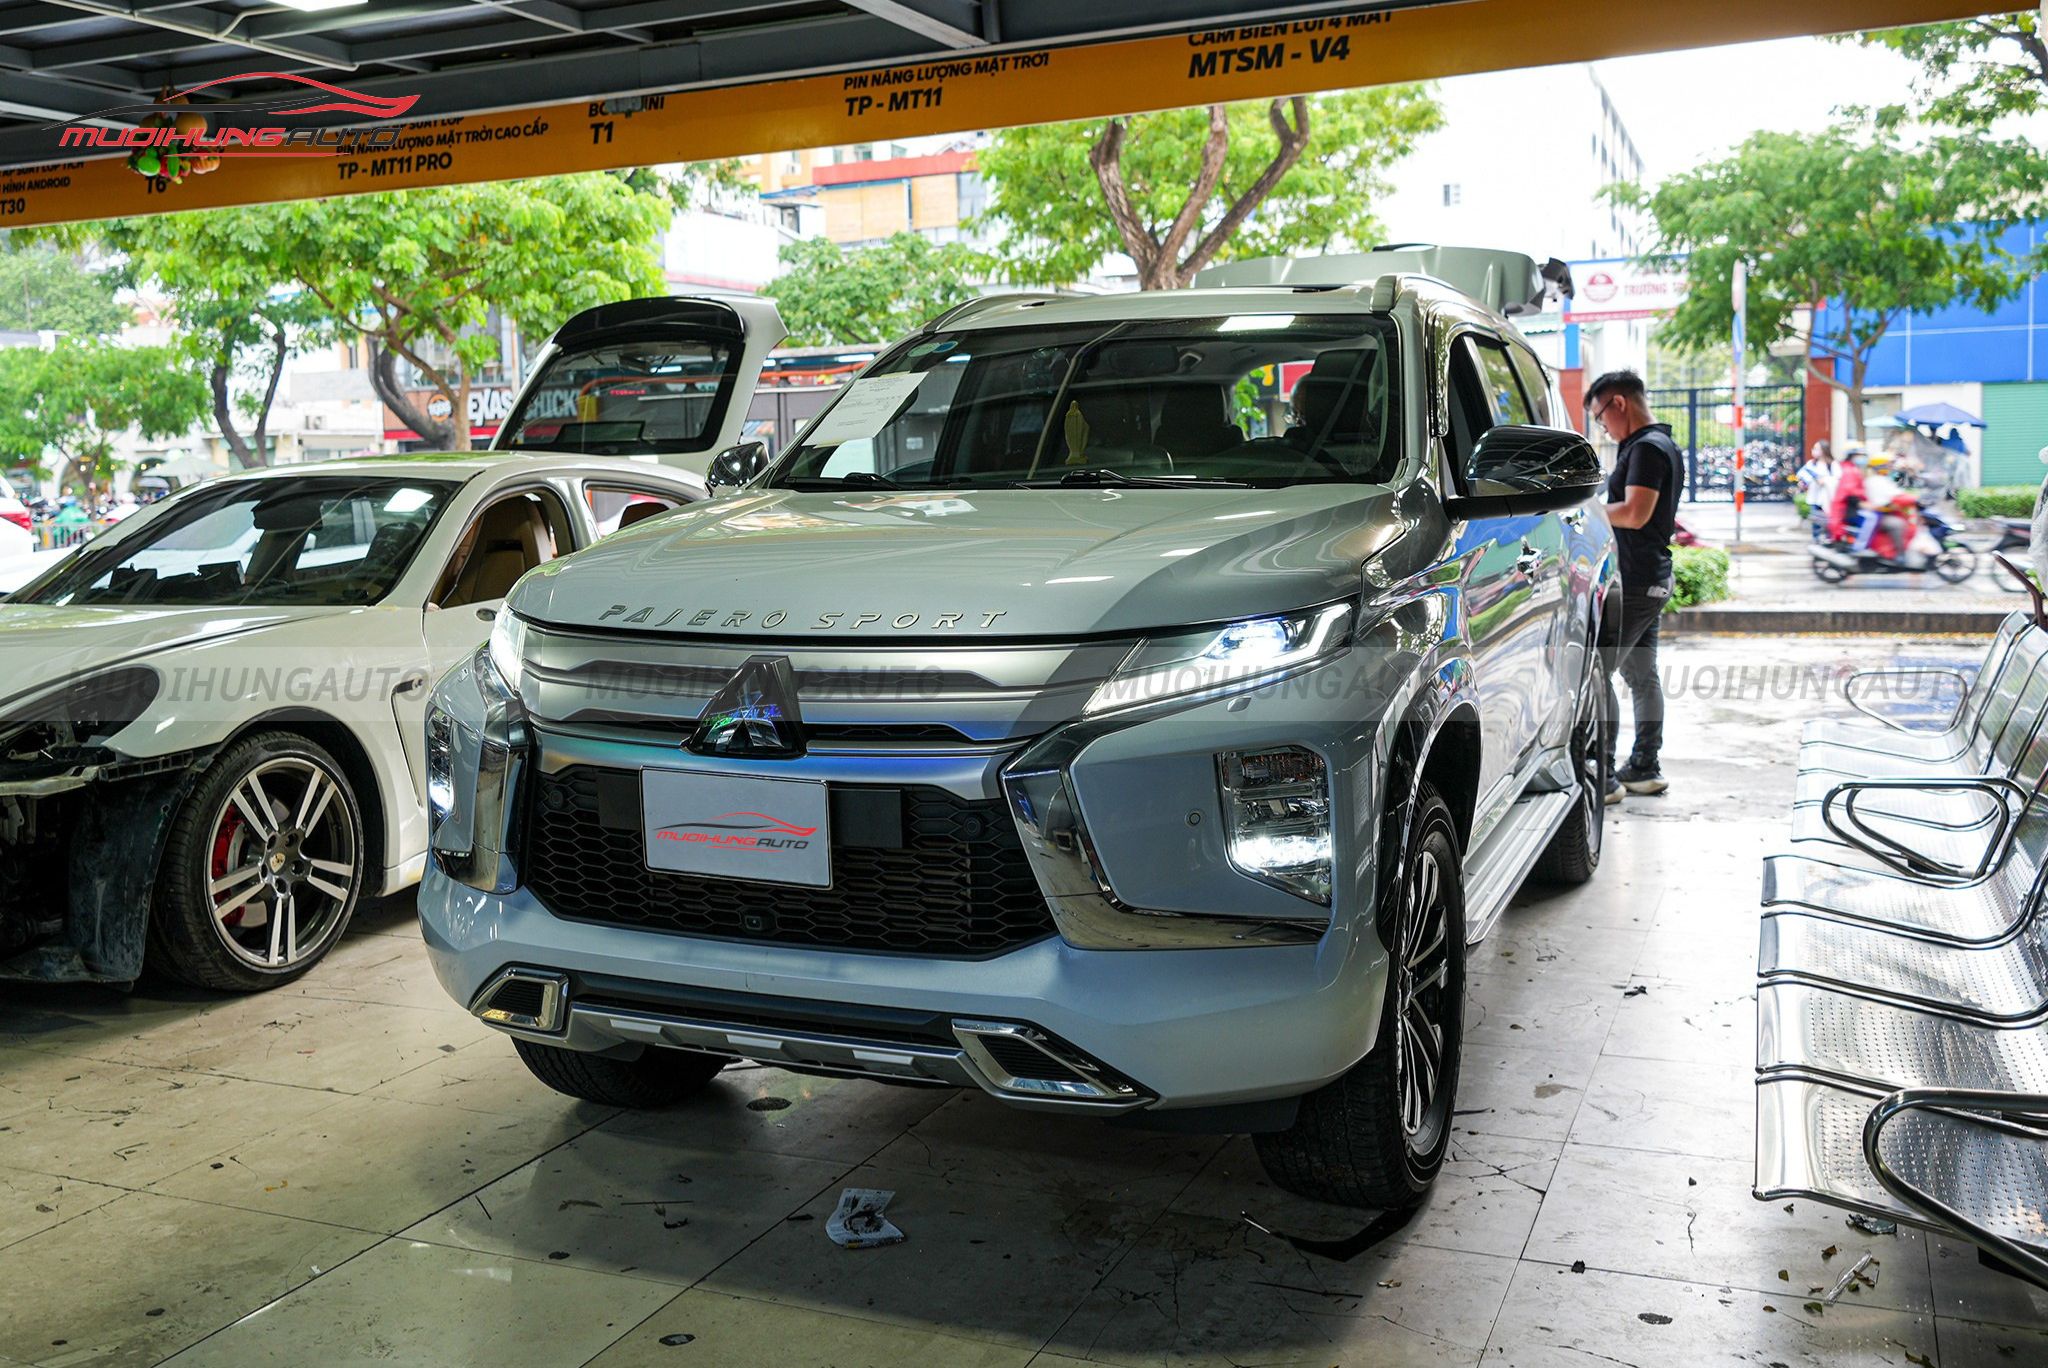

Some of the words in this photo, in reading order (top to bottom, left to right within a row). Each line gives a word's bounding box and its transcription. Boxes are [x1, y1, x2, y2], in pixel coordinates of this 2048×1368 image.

[1188, 43, 1285, 78] MTSM
[1309, 35, 1351, 64] V4
[843, 76, 868, 90] PIN
[845, 95, 873, 116] TP
[888, 87, 943, 112] MT11
[494, 125, 521, 140] CAO
[590, 121, 614, 144] T1
[337, 161, 359, 180] TP
[371, 156, 412, 177] MT11
[416, 152, 453, 172] PRO
[27, 176, 71, 191] ANDROID
[145, 175, 168, 194] T6
[467, 387, 514, 426] EXAS
[598, 604, 789, 630] PAJERO
[810, 609, 1008, 631] SPORT
[656, 830, 810, 850] MUOIHUNGAUTO
